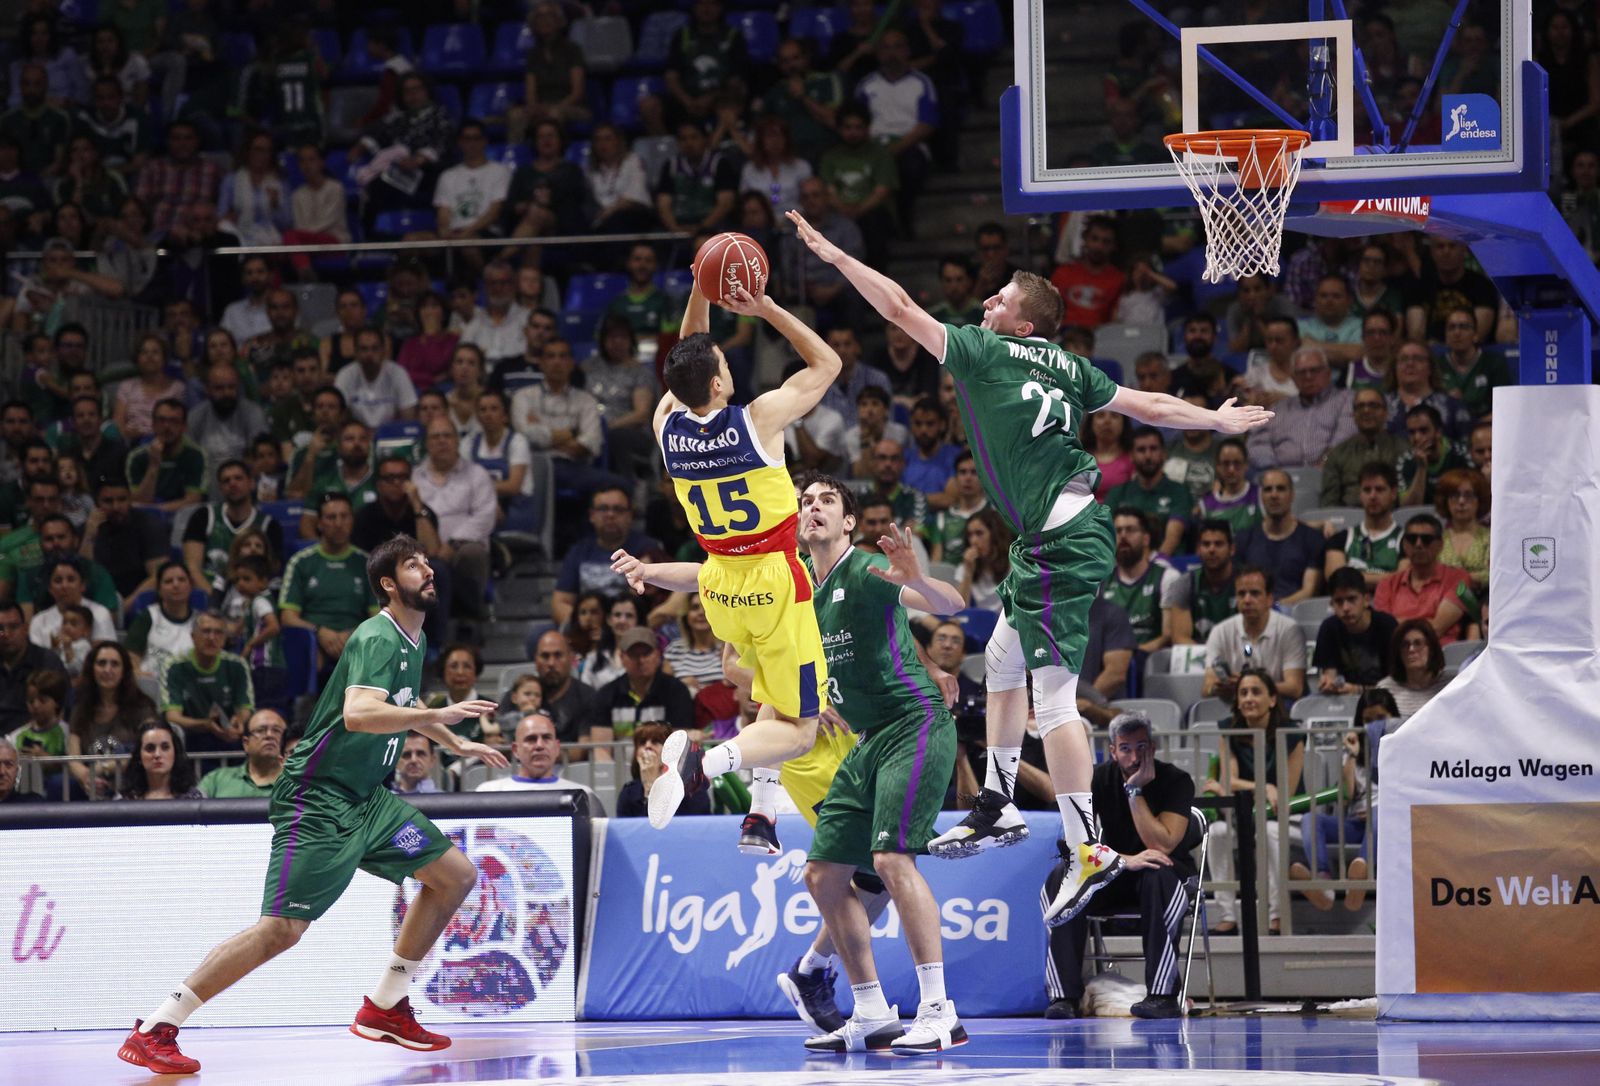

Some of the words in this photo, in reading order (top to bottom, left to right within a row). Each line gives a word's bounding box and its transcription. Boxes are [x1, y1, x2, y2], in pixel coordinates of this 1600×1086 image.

[1460, 114, 1478, 131] liga
[1460, 128, 1497, 139] endesa
[1021, 381, 1071, 438] 21
[668, 427, 740, 453] NAVARRO
[687, 477, 761, 536] 15
[827, 676, 844, 706] 3
[382, 737, 399, 766] 11
[1429, 759, 1512, 783] Málaga
[1518, 758, 1594, 782] Wagen
[642, 853, 748, 954] liga
[1430, 877, 1492, 907] Das
[12, 884, 66, 963] ti
